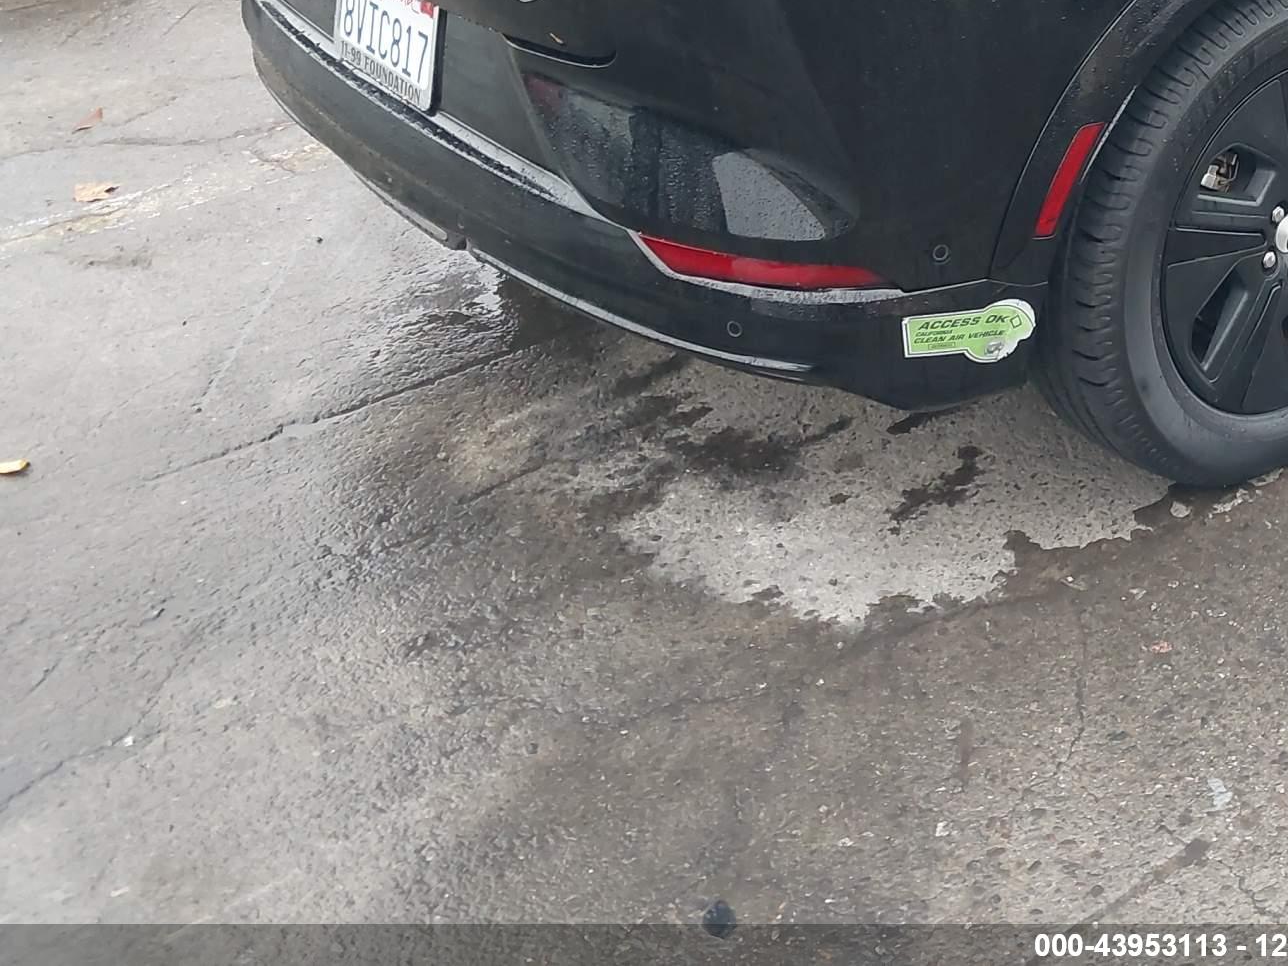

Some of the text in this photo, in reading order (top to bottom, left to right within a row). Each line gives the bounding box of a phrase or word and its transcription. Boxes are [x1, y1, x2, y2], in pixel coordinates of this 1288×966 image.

[341, 40, 421, 105] 11-99 FOUNDATION
[918, 314, 1011, 331] ACCESS OK
[913, 335, 946, 344] CLEAN
[968, 330, 1006, 339] VEHICLE
